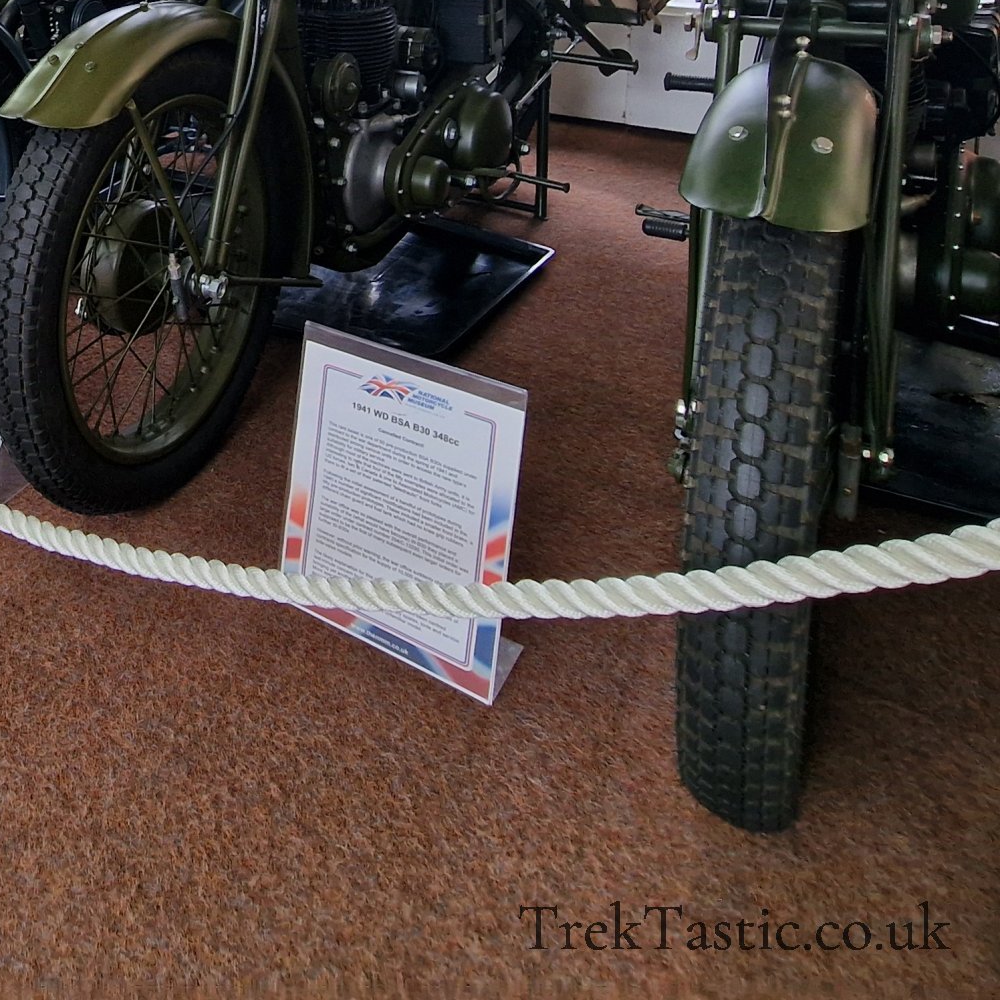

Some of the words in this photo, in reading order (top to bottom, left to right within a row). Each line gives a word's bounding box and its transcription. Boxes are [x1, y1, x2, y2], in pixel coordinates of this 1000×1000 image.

[407, 398, 435, 410] MUSEUM
[412, 394, 453, 411] MOTORCYCLE
[418, 390, 450, 404] NATIONAL
[352, 402, 371, 414] 1941
[373, 409, 389, 420] WD
[391, 415, 410, 429] BSA
[412, 423, 431, 436] B30
[433, 430, 460, 447] 348cc
